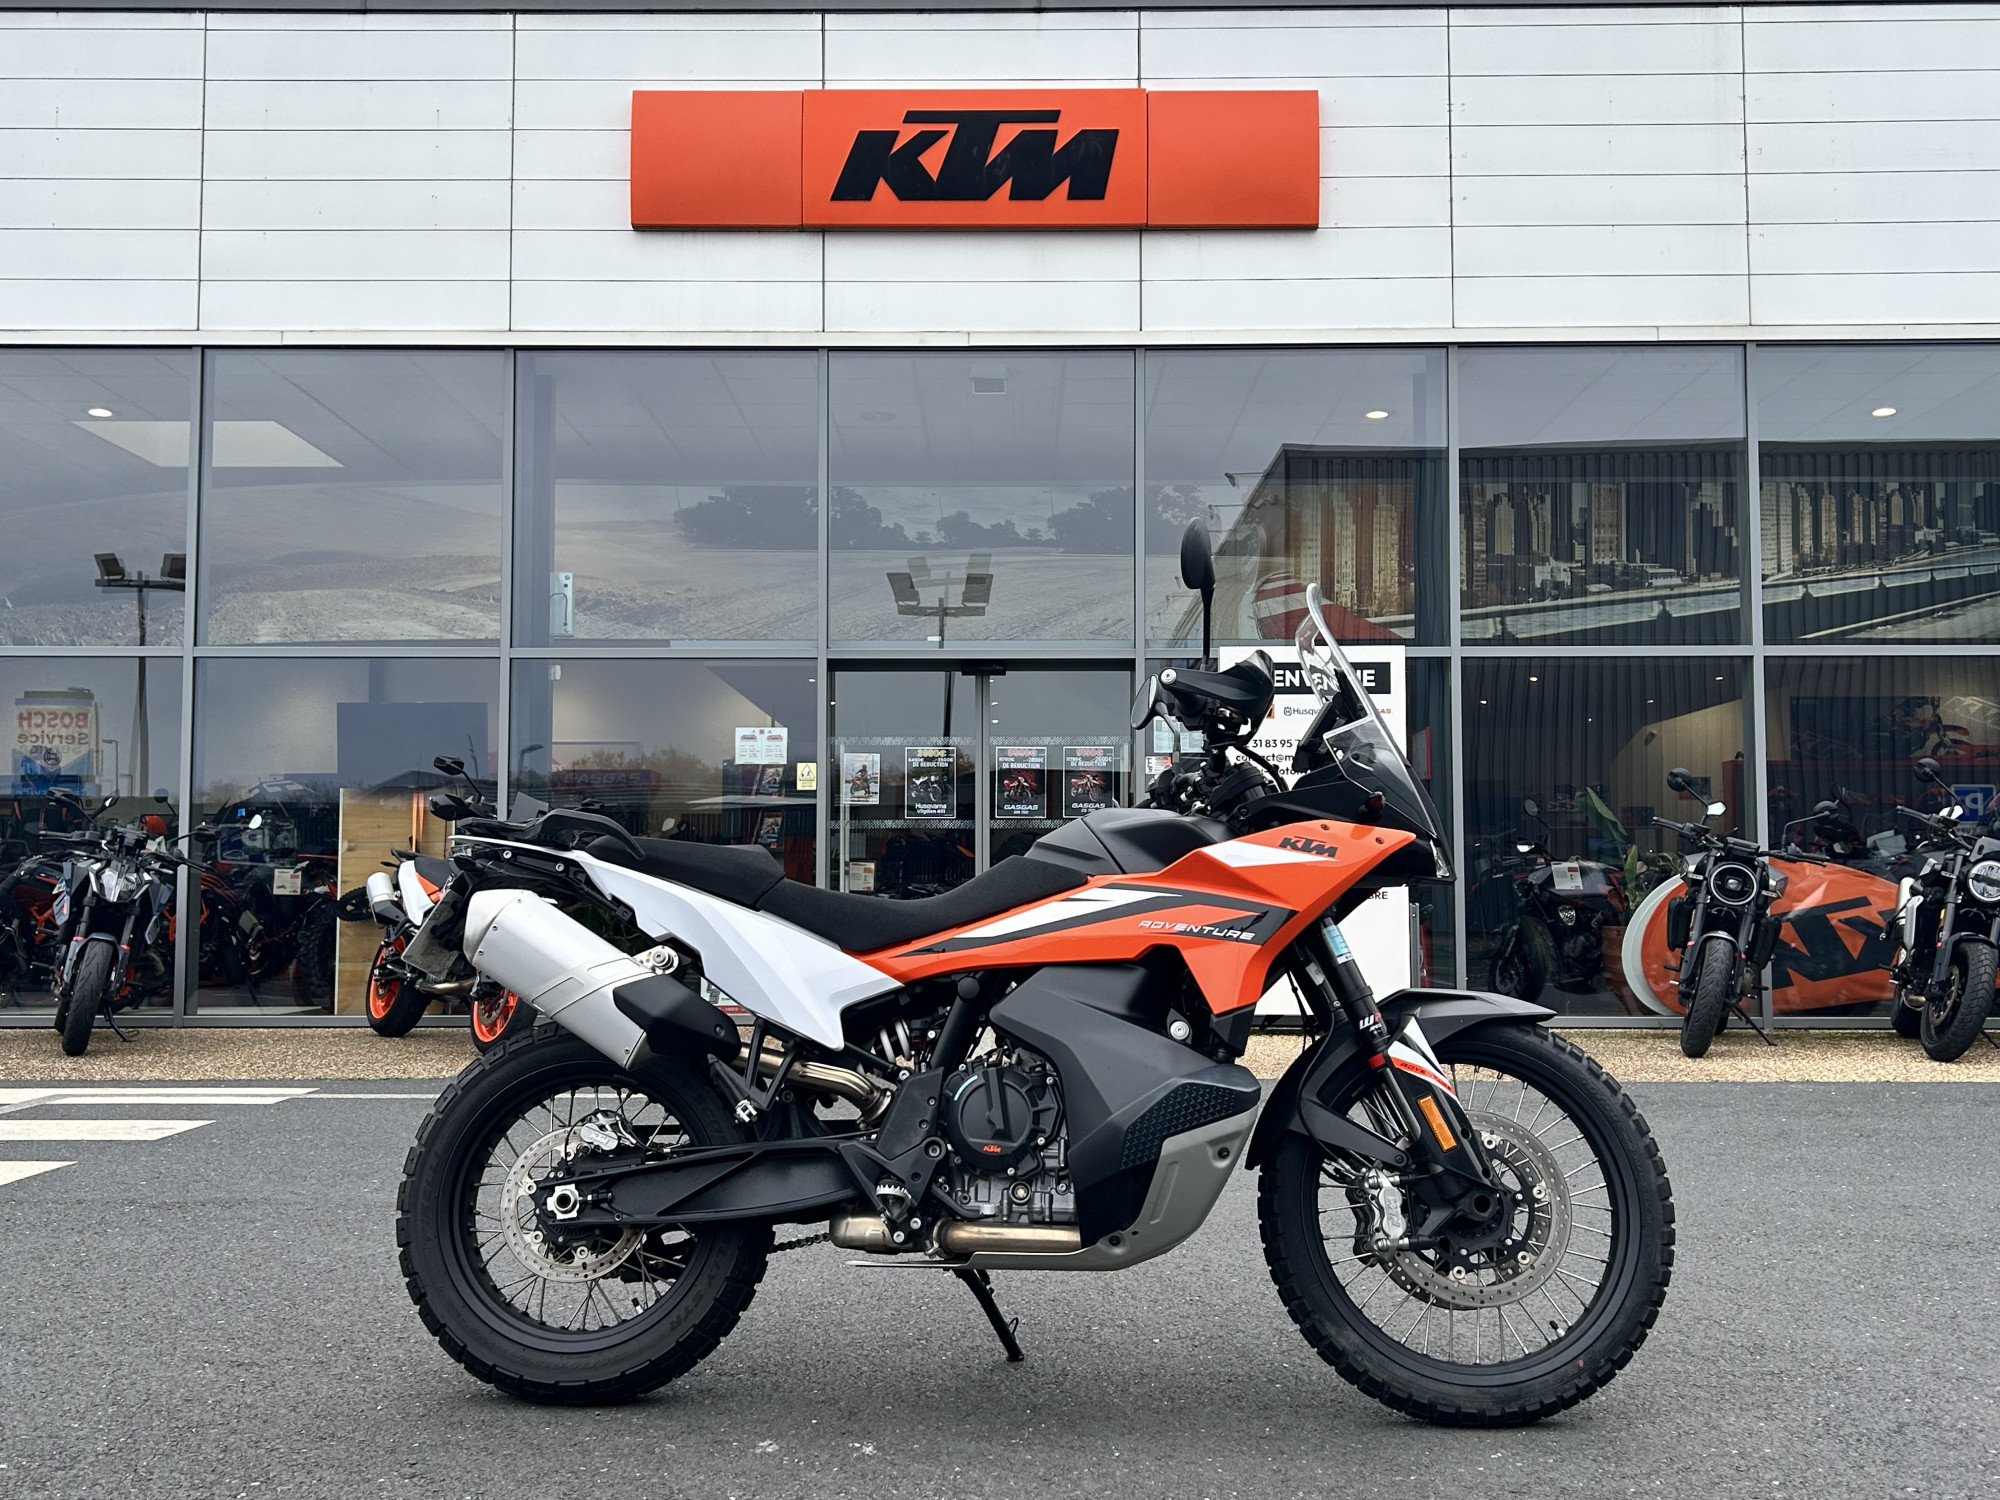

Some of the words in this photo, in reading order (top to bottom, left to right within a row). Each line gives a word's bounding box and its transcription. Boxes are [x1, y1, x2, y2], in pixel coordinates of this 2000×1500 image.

[830, 109, 1119, 201] KTM
[1293, 707, 1319, 716] Husqv
[1264, 739, 1278, 748] 83
[1279, 739, 1293, 748] 95
[1279, 836, 1338, 858] KTM
[1137, 920, 1256, 941] ADVENTURE
[1359, 1012, 1382, 1030] WP
[982, 1144, 1001, 1154] KTM
